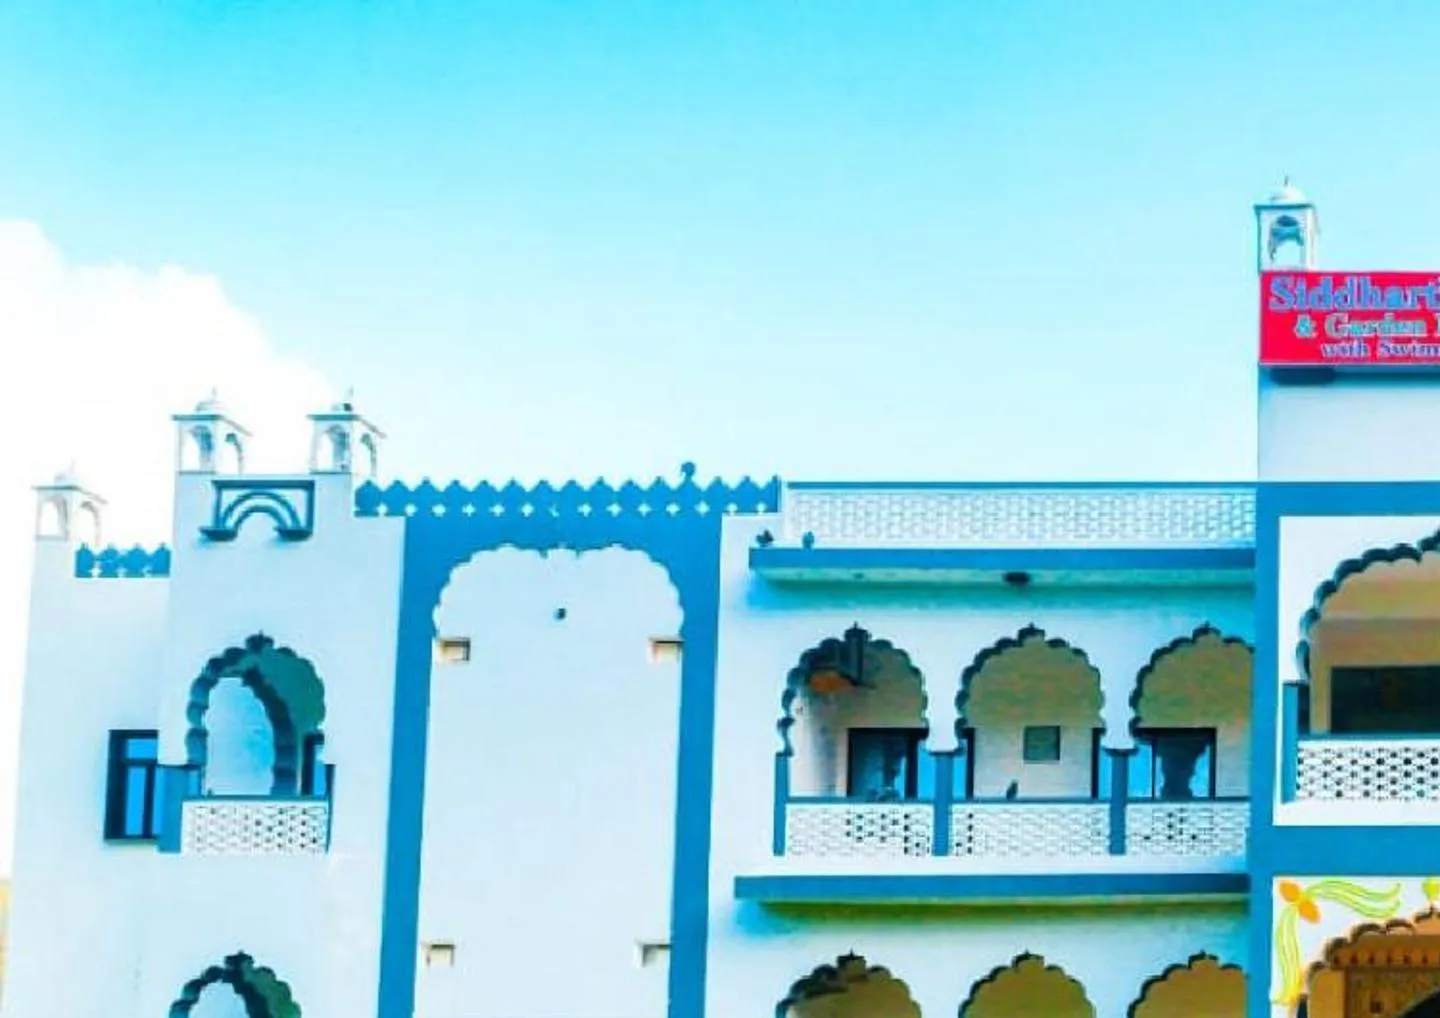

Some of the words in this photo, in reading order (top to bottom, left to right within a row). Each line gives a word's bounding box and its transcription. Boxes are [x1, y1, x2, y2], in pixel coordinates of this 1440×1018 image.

[1294, 314, 1317, 338] &
[1324, 313, 1427, 337] Garden
[1321, 340, 1370, 358] with
